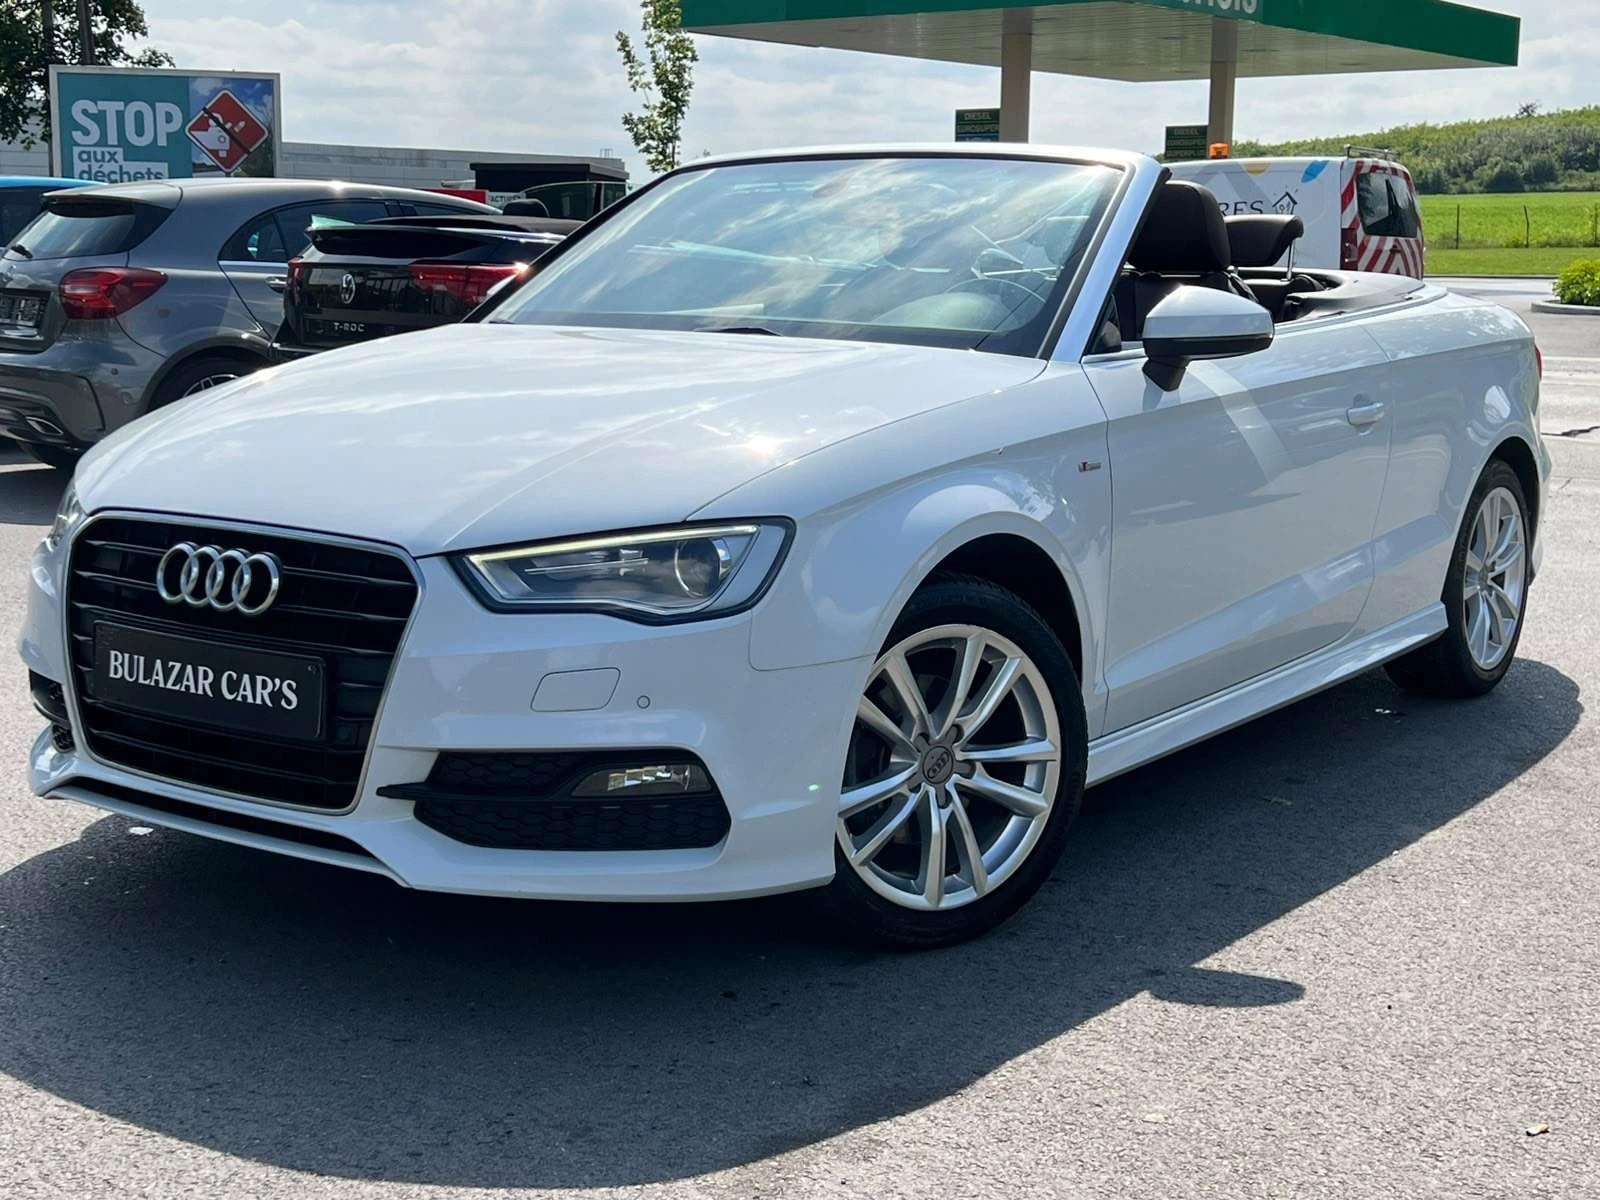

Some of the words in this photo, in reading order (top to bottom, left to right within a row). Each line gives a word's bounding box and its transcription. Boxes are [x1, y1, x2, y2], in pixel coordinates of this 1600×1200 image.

[71, 99, 183, 146] STOP
[78, 150, 119, 163] aux
[333, 322, 365, 332] T-ROC
[109, 650, 214, 698] BULAZAR
[221, 671, 298, 710] CAR'S
